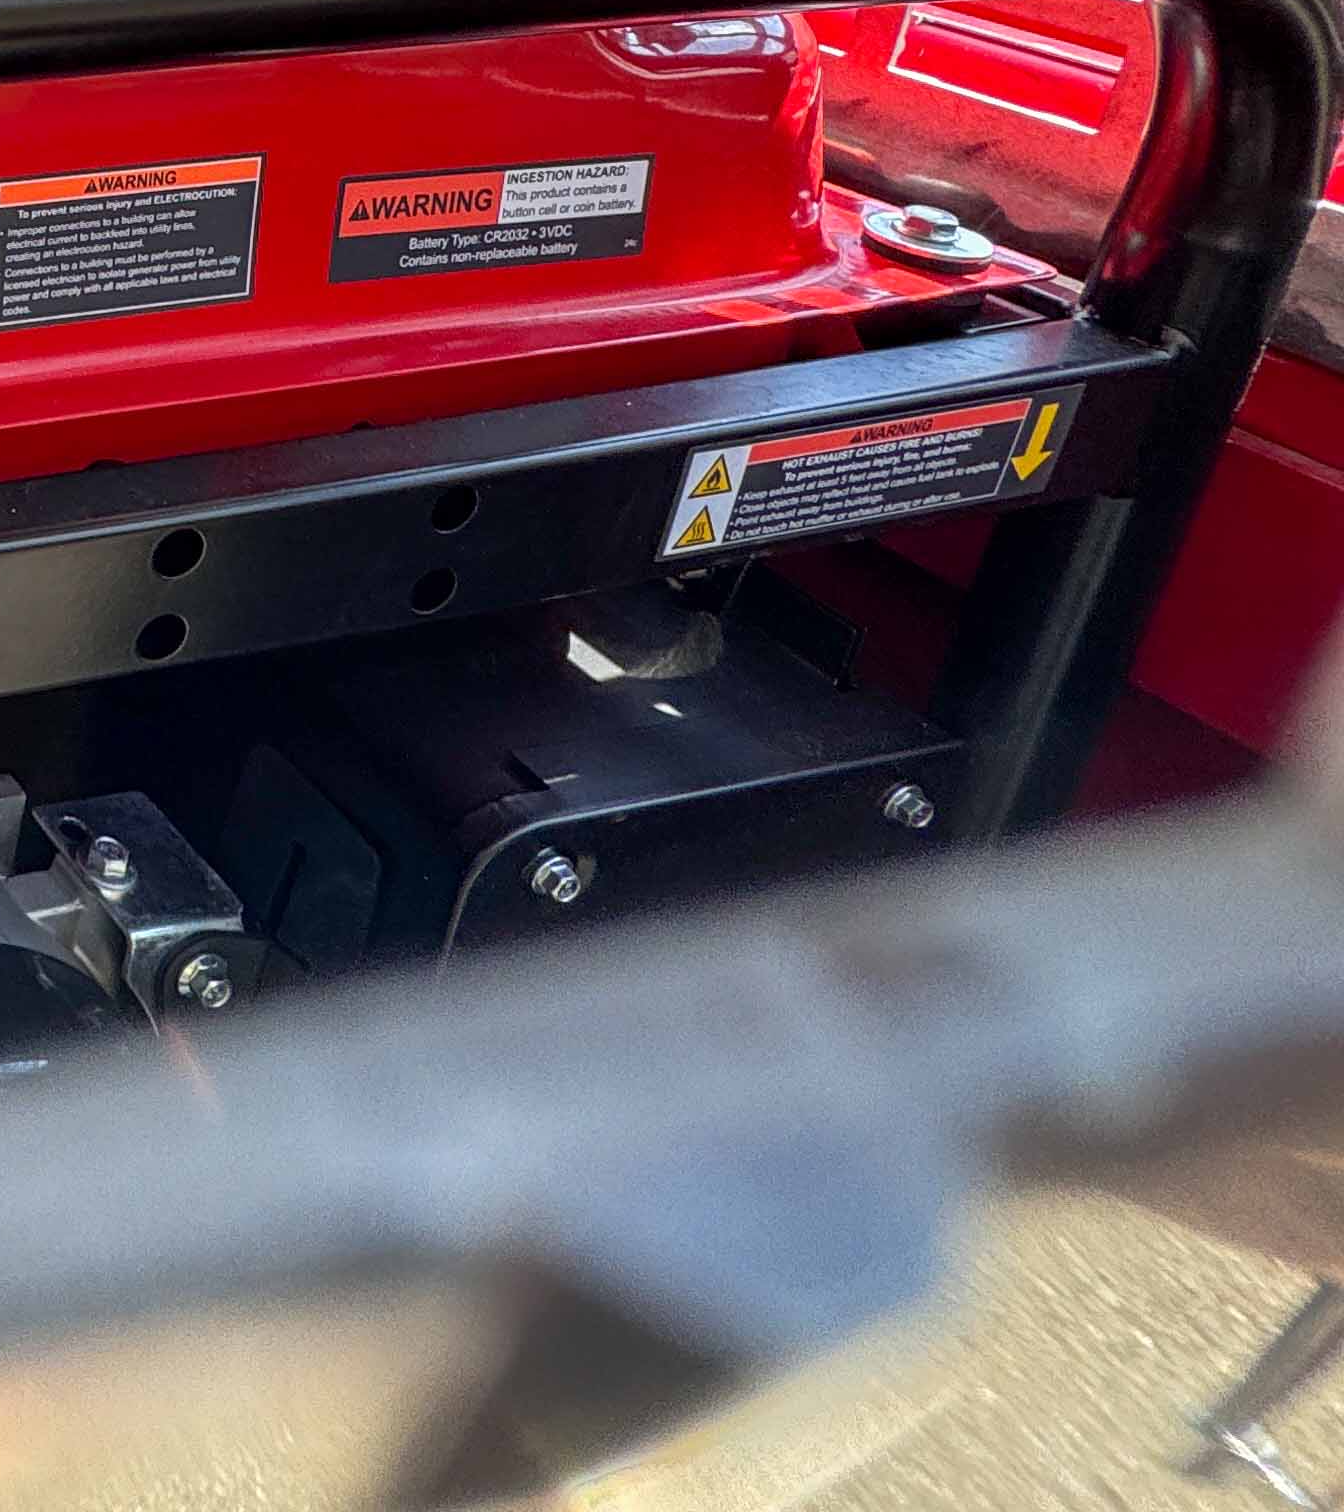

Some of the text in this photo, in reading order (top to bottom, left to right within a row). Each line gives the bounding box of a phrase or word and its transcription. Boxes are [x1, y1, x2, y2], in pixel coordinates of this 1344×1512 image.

[97, 171, 177, 192] WARNING
[506, 164, 630, 185] INGESTION HAZARD:
[505, 182, 627, 202] This product contains a
[370, 188, 493, 220] WARNING
[501, 198, 635, 219] button cell or coin battery.
[408, 224, 573, 249] Battery Type: CR2032 3VDC
[398, 243, 577, 268] Contains non-replaceable battery
[862, 418, 934, 442] WARNING
